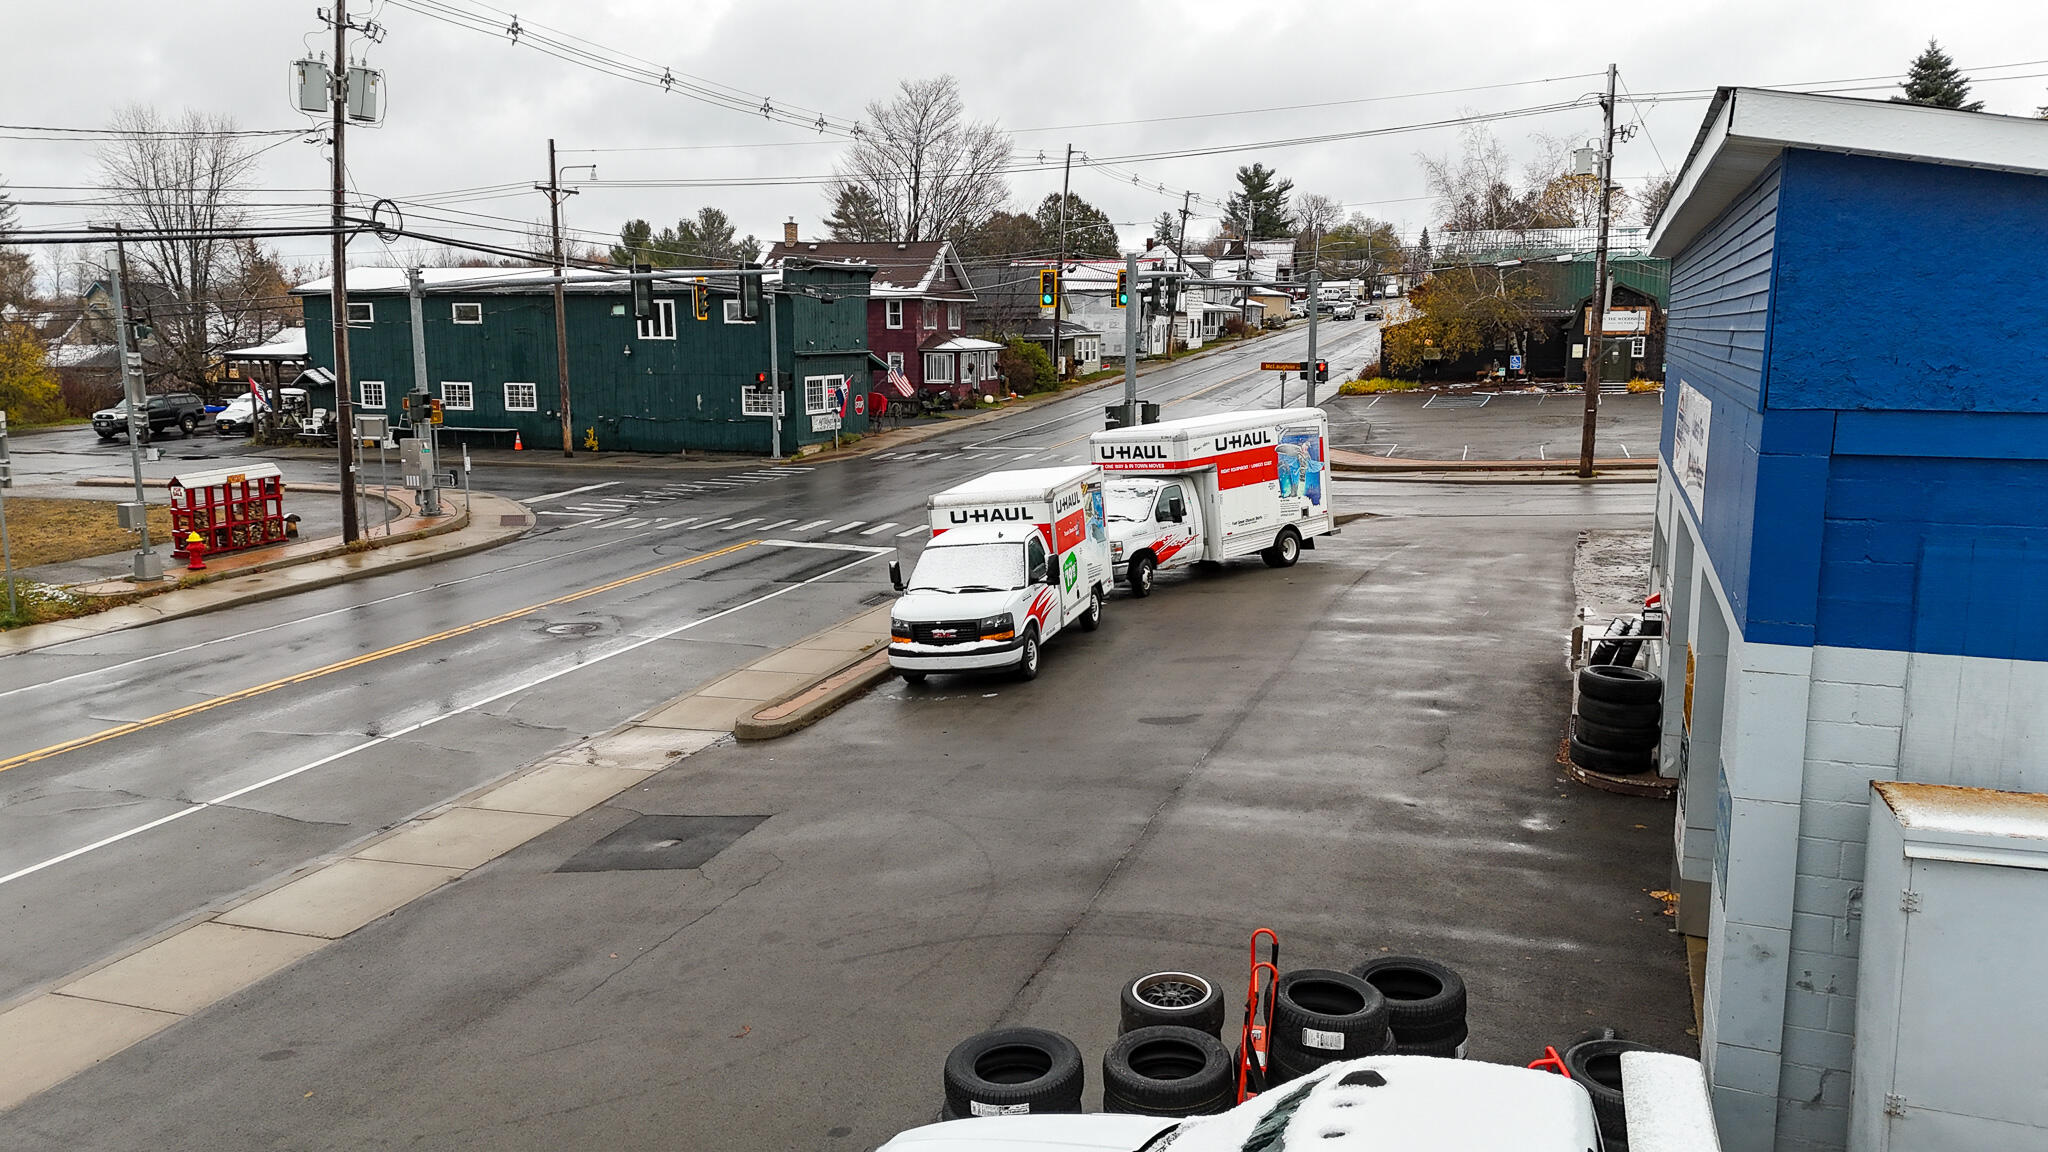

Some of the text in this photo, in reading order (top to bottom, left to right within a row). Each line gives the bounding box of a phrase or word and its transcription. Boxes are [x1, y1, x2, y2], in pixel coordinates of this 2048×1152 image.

[1215, 430, 1271, 452] U-HAUL
[1100, 445, 1167, 459] U-HAUL
[1055, 491, 1081, 514] U-HAUL
[950, 507, 1034, 524] U-HAUL
